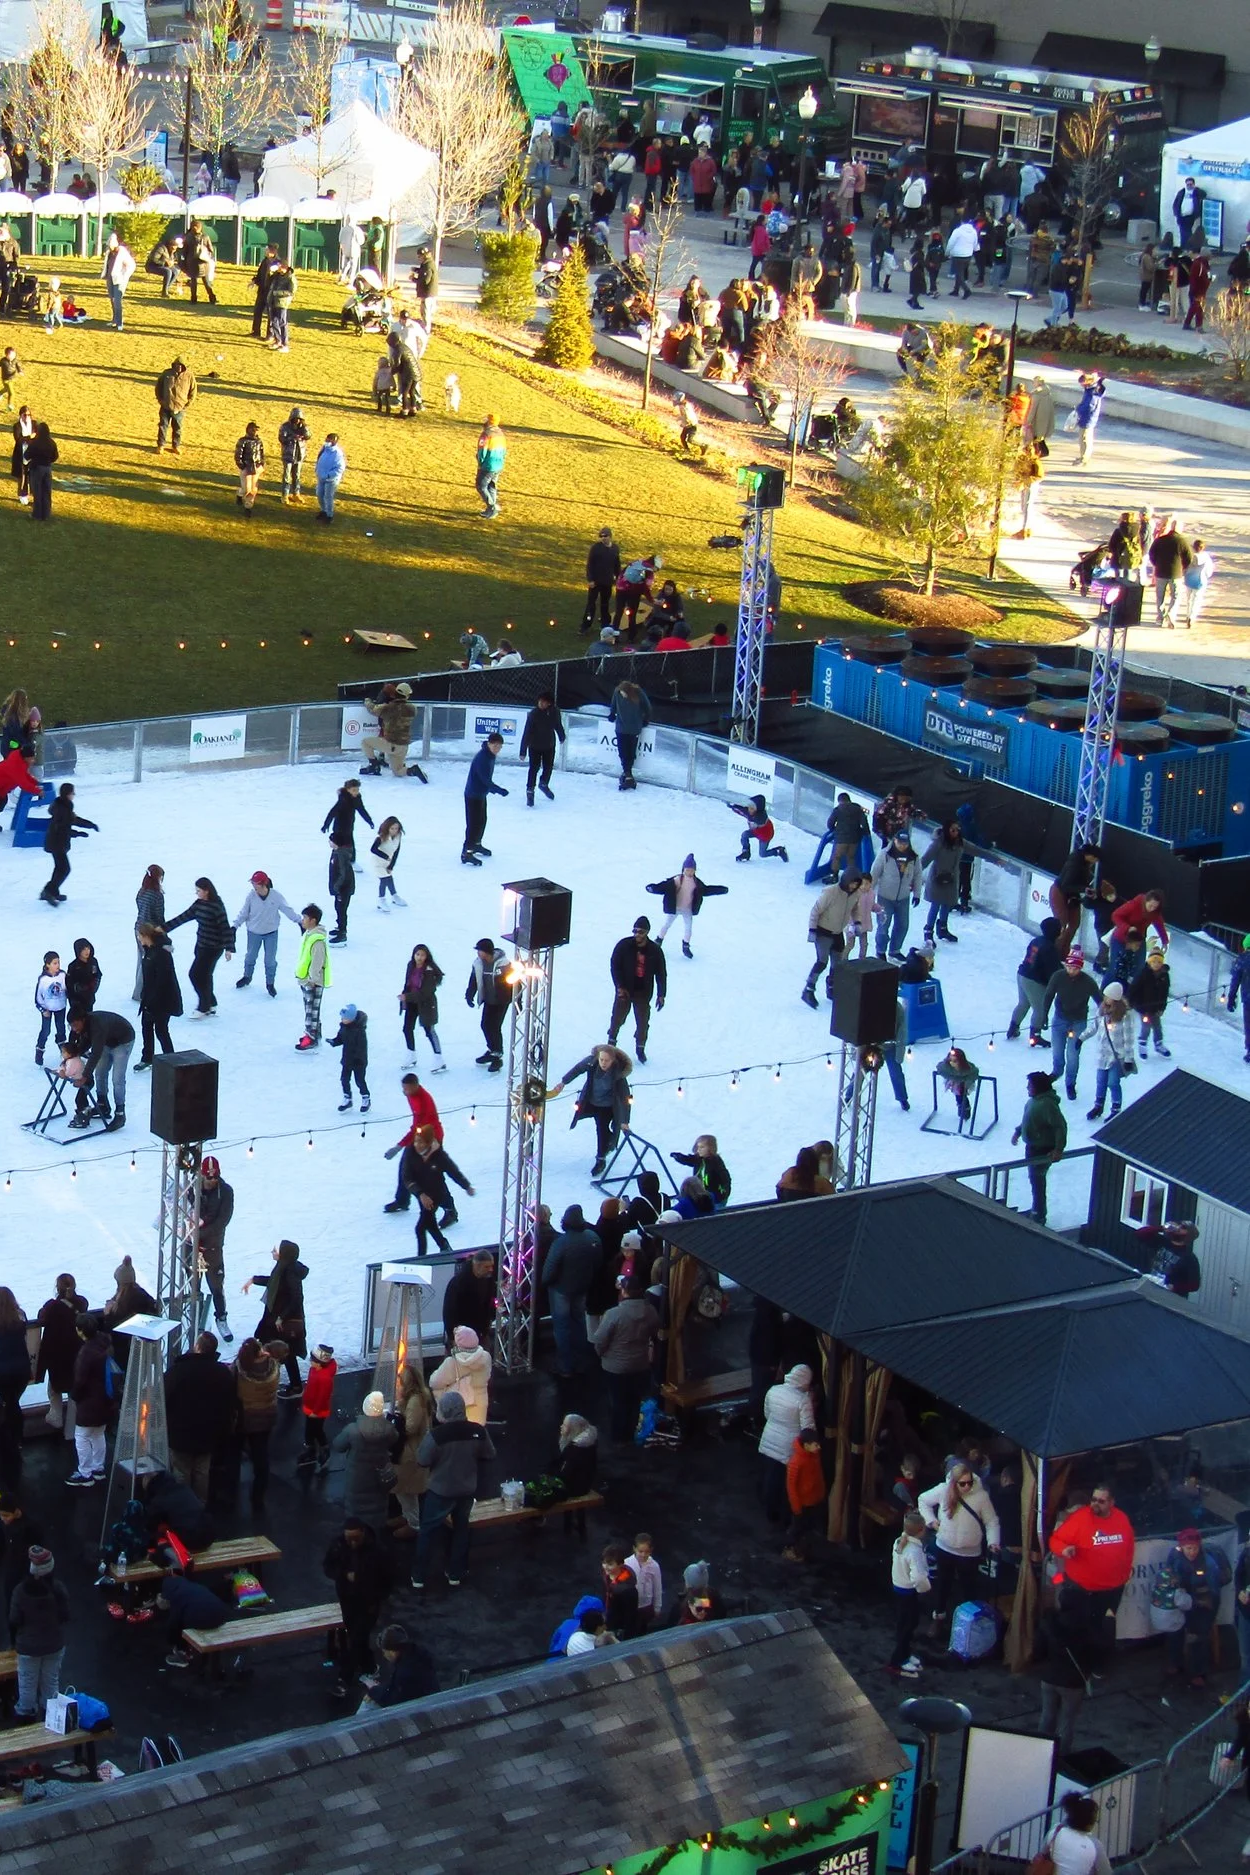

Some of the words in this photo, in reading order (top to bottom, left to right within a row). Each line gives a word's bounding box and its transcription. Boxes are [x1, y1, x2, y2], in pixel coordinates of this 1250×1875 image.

[926, 711, 955, 738] DTE
[199, 733, 236, 745] OAKLAND
[954, 724, 993, 740] POWERED
[994, 734, 1005, 744] BY
[600, 735, 652, 753] ACRN
[971, 736, 1003, 753] ENERGY
[730, 763, 772, 781] ALLINGHAM
[818, 1847, 869, 1875] SKATE
